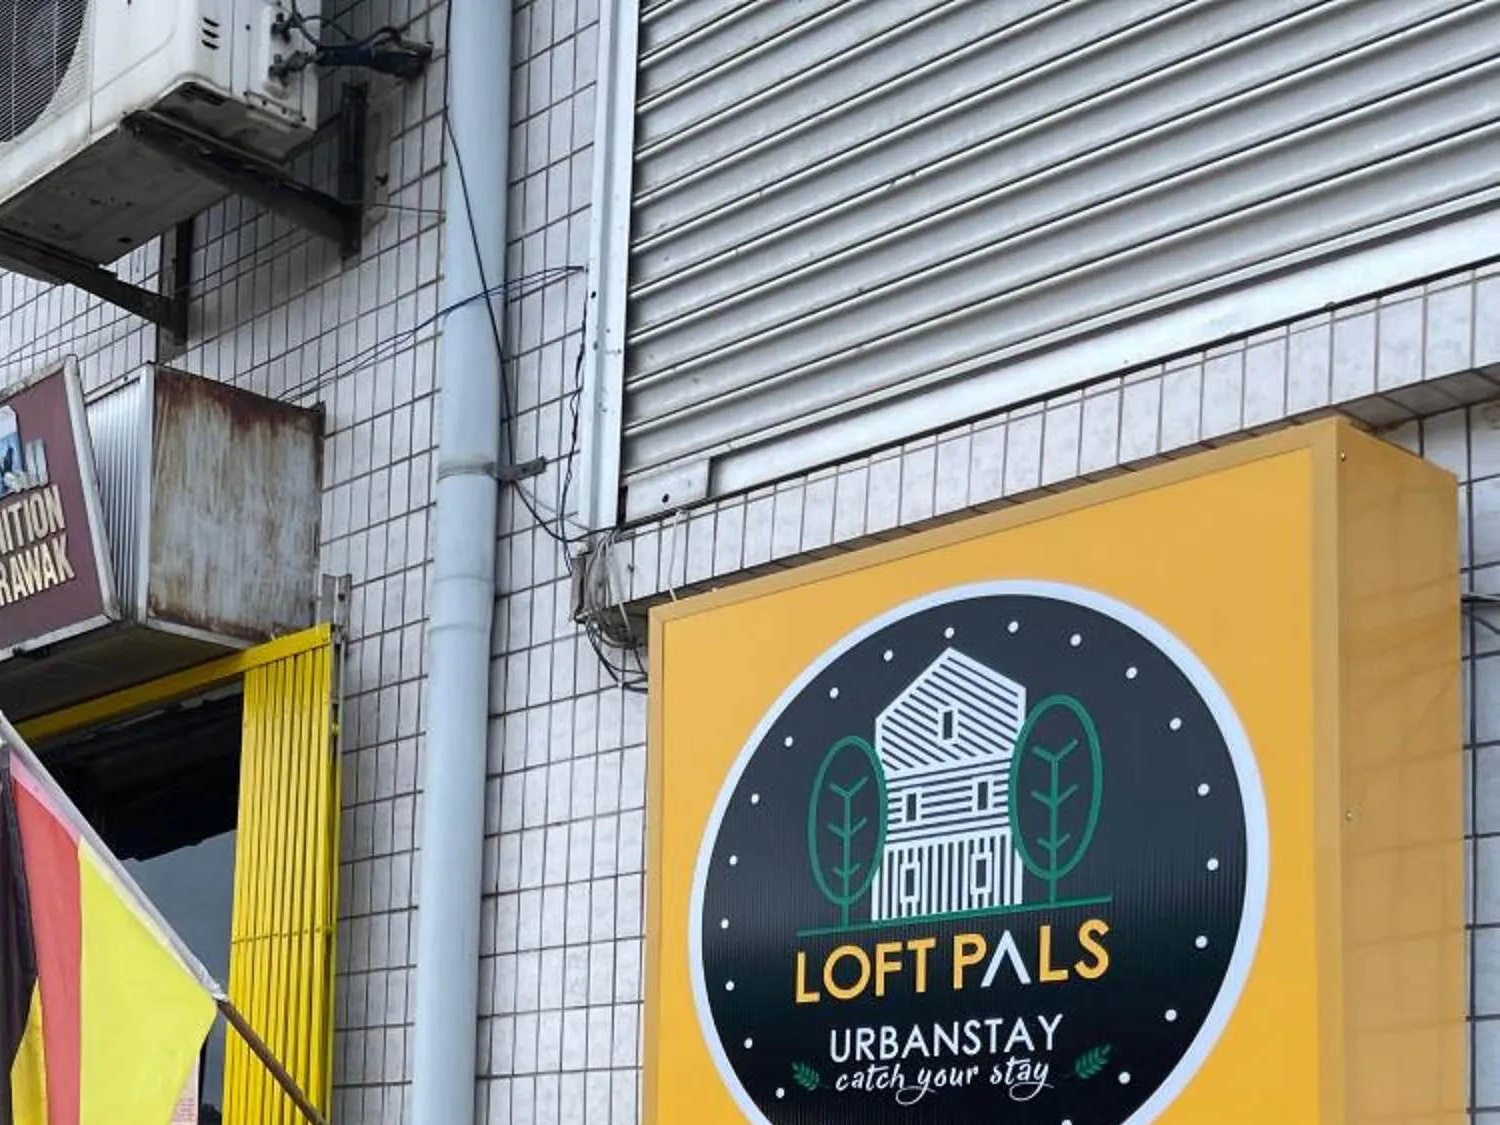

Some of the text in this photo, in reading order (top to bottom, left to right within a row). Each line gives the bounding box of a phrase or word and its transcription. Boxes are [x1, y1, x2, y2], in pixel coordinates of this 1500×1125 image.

[796, 919, 1109, 1003] LOFT PALS
[830, 1013, 1063, 1063] URBANSTAY
[835, 1056, 1054, 1106] catch your stay
